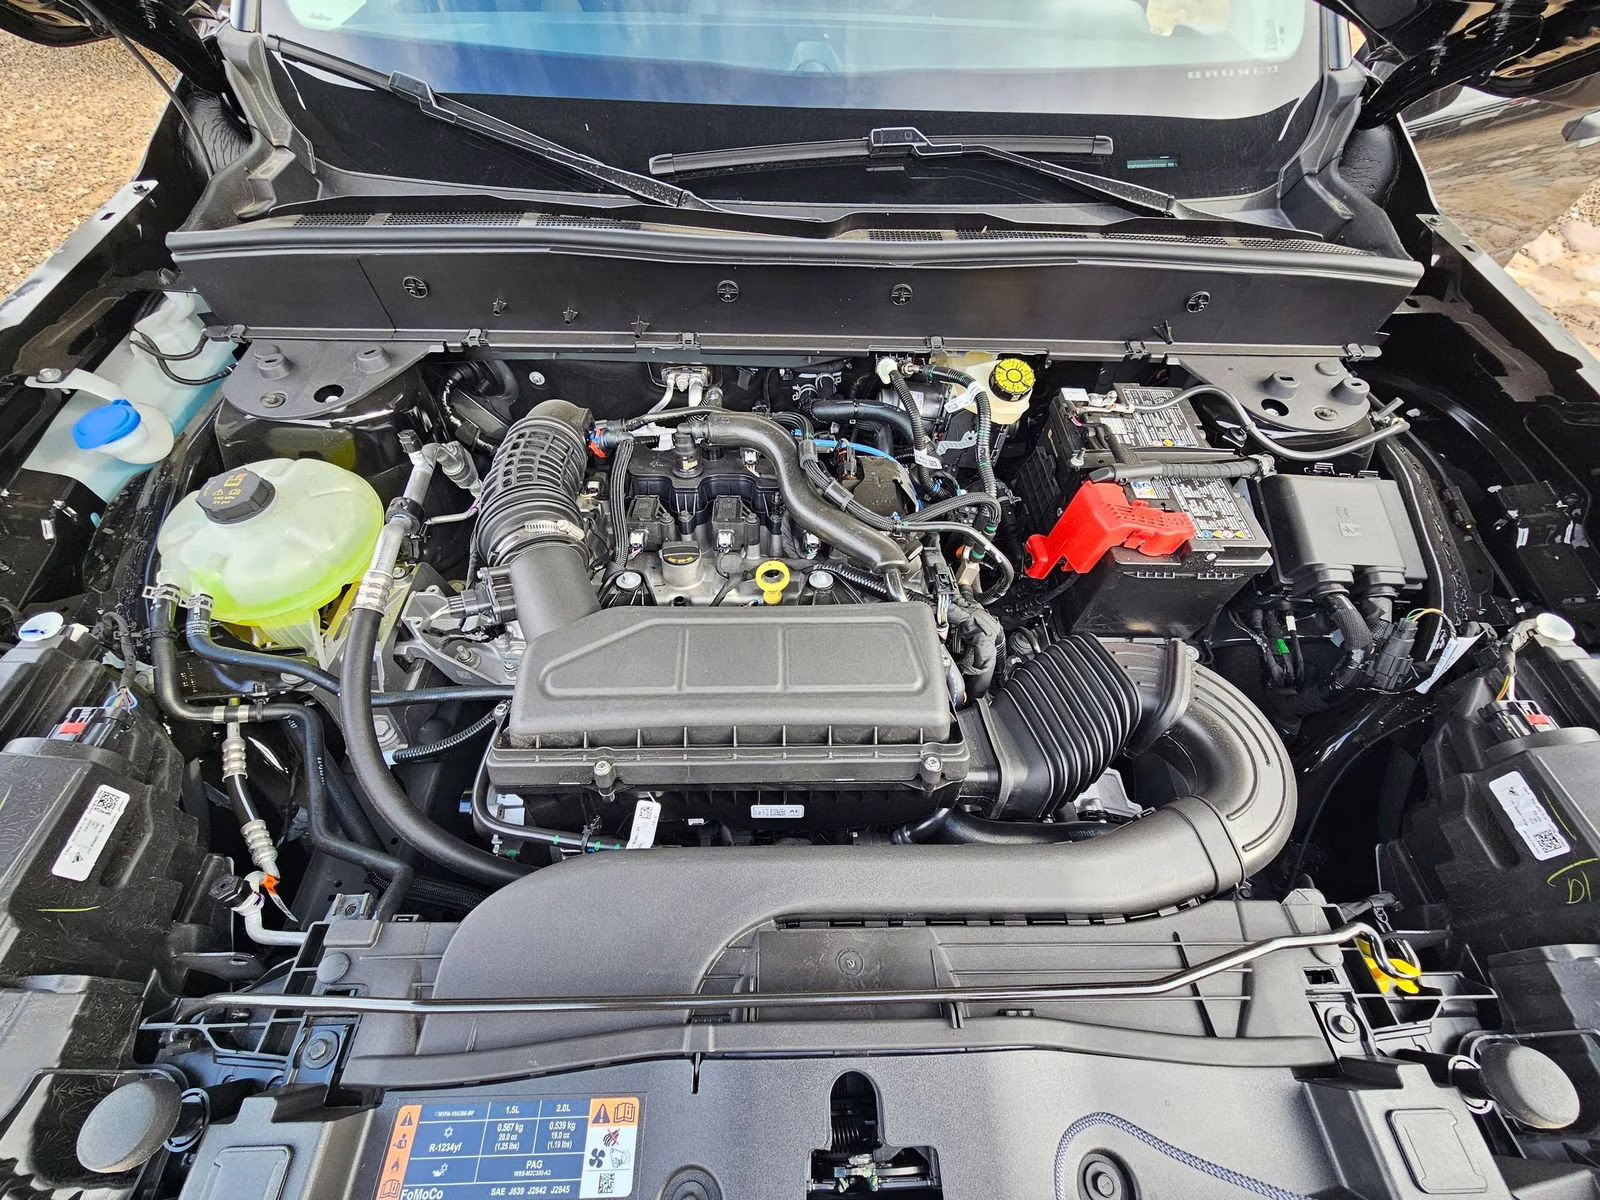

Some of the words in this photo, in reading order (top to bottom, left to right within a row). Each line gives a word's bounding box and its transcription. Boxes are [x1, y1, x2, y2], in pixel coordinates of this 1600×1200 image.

[1187, 64, 1279, 80] BRONCO
[506, 1105, 520, 1114] 1.5L
[556, 1103, 571, 1113] 2.0L
[497, 1123, 514, 1132] 0.567
[515, 1122, 524, 1133] kg
[549, 1121, 566, 1130] 0.539
[567, 1121, 576, 1131] kg
[429, 1142, 463, 1153] R-1234yf
[526, 1160, 543, 1169] PAG
[401, 1187, 444, 1200] FoMoCo
[491, 1187, 506, 1196] SAE
[508, 1186, 525, 1196] J639
[527, 1186, 547, 1195] J2842
[550, 1185, 571, 1194] J2845
